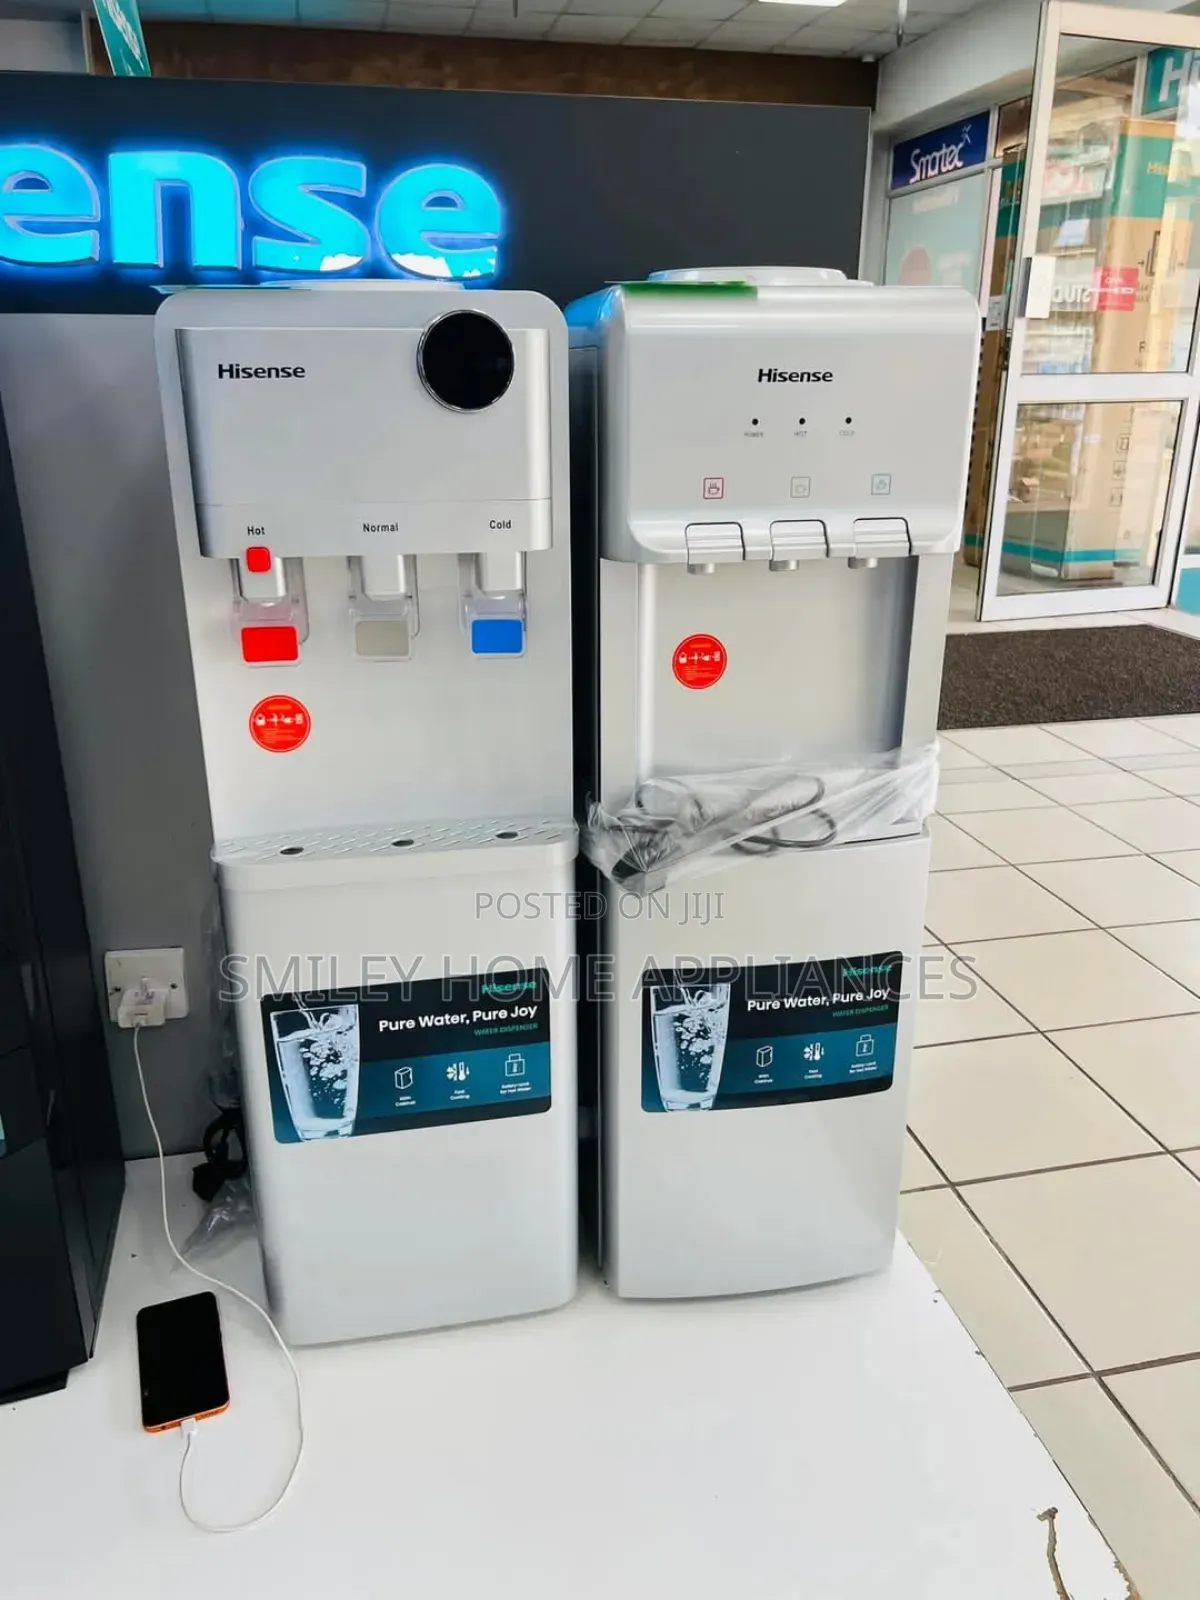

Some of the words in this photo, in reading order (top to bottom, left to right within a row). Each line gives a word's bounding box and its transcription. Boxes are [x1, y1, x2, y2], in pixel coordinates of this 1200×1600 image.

[0, 143, 502, 281] ense
[217, 363, 306, 379] Hisense
[757, 368, 834, 383] Hisense
[246, 525, 266, 537] Hot
[362, 522, 400, 534] Normal
[489, 519, 512, 531] Cold
[747, 999, 781, 1012] Pure
[783, 994, 830, 1009] Water,
[832, 991, 864, 1004] Pure
[866, 987, 891, 1000] Joy
[378, 1018, 416, 1032] Pure
[418, 1012, 470, 1028] Water,
[472, 1009, 508, 1023] Pure
[510, 1005, 538, 1019] Joy
